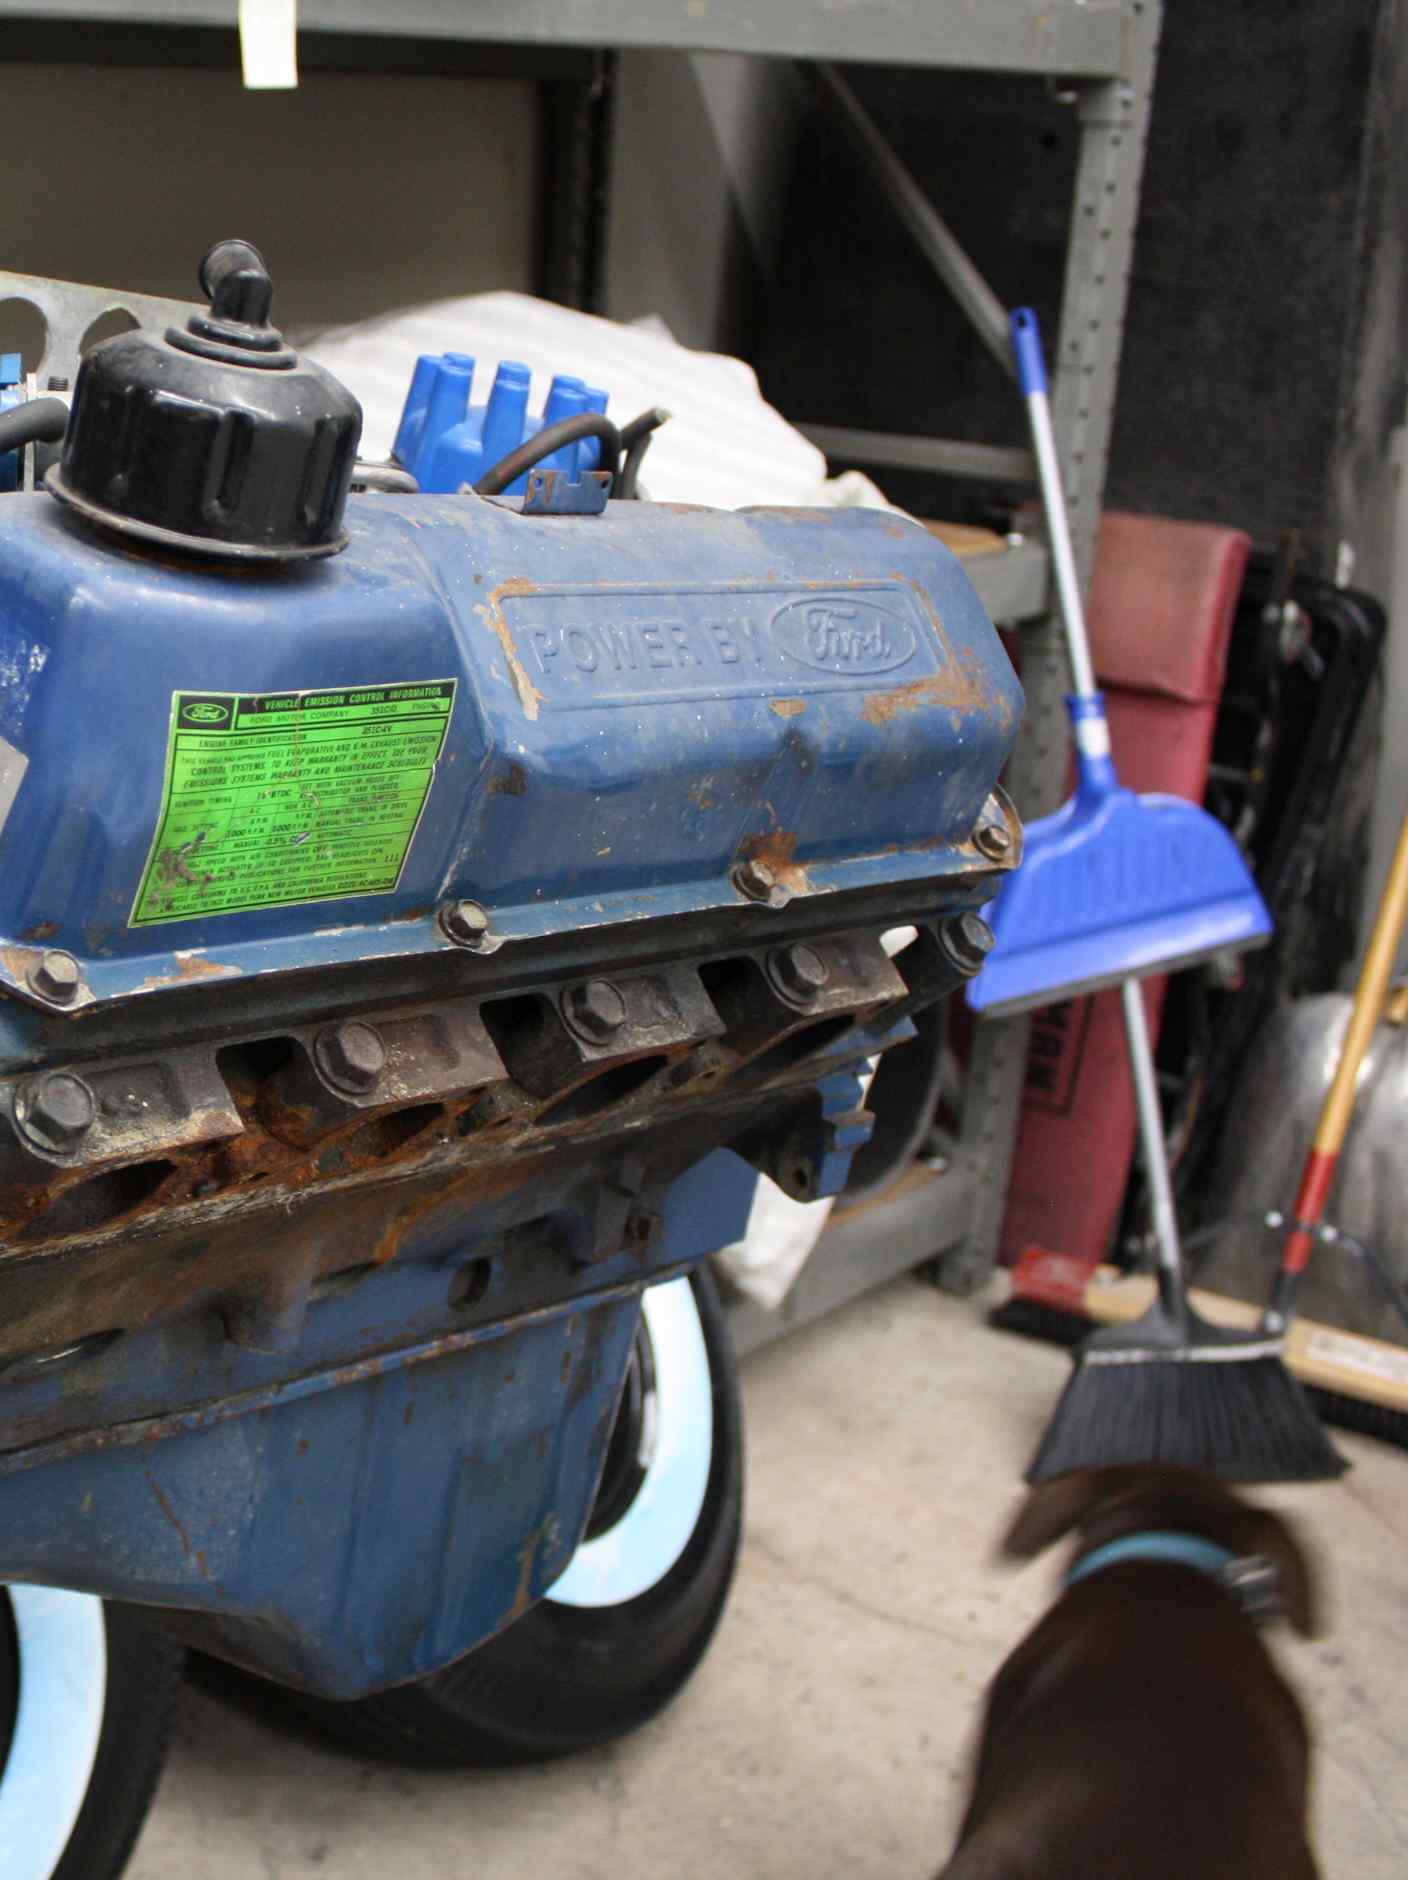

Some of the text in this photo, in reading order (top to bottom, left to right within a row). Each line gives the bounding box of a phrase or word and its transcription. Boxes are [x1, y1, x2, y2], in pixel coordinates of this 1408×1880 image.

[804, 607, 892, 662] Ford
[527, 619, 702, 673] POWER
[265, 687, 442, 710] VEHICLE EMISSION CONTROL INFORMATION
[191, 703, 221, 720] Ford
[277, 713, 304, 722] MOTOR
[311, 711, 349, 720] COMPANY
[191, 765, 226, 776] CONTROL
